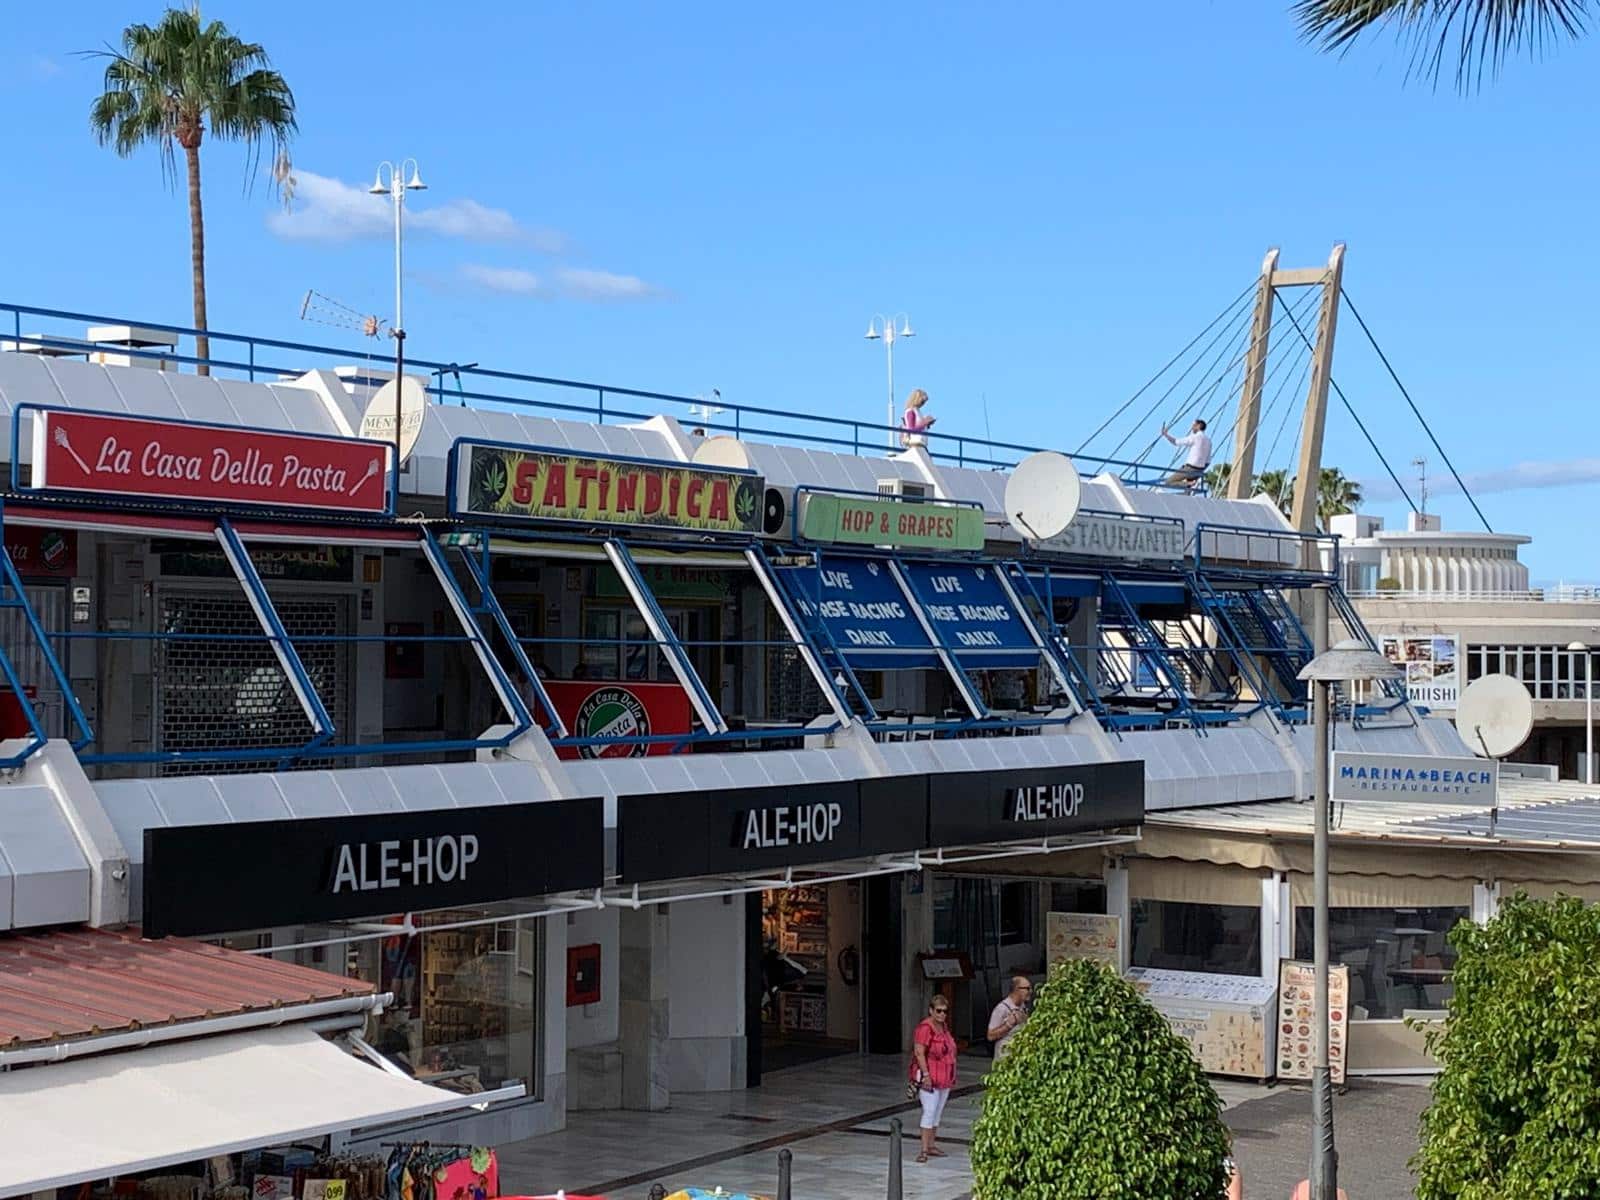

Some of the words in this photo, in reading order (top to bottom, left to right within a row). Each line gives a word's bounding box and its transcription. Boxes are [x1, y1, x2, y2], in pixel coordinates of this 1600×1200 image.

[95, 436, 132, 474] La
[141, 441, 202, 480] Casa
[210, 447, 273, 486] Della
[279, 455, 346, 492] Pasta
[841, 509, 874, 532] HOP
[880, 512, 890, 533] &
[898, 513, 954, 539] GRAPES
[1050, 522, 1182, 554] STAURANTE
[820, 569, 854, 590] LIVE
[930, 576, 963, 593] LIVE
[848, 602, 906, 620] RACING
[925, 604, 960, 621] RSE
[958, 604, 1010, 621] RACING
[1014, 783, 1085, 821] ALE-HOP
[743, 802, 841, 849] ALE-HOP
[332, 834, 479, 894] ALE-HOP
